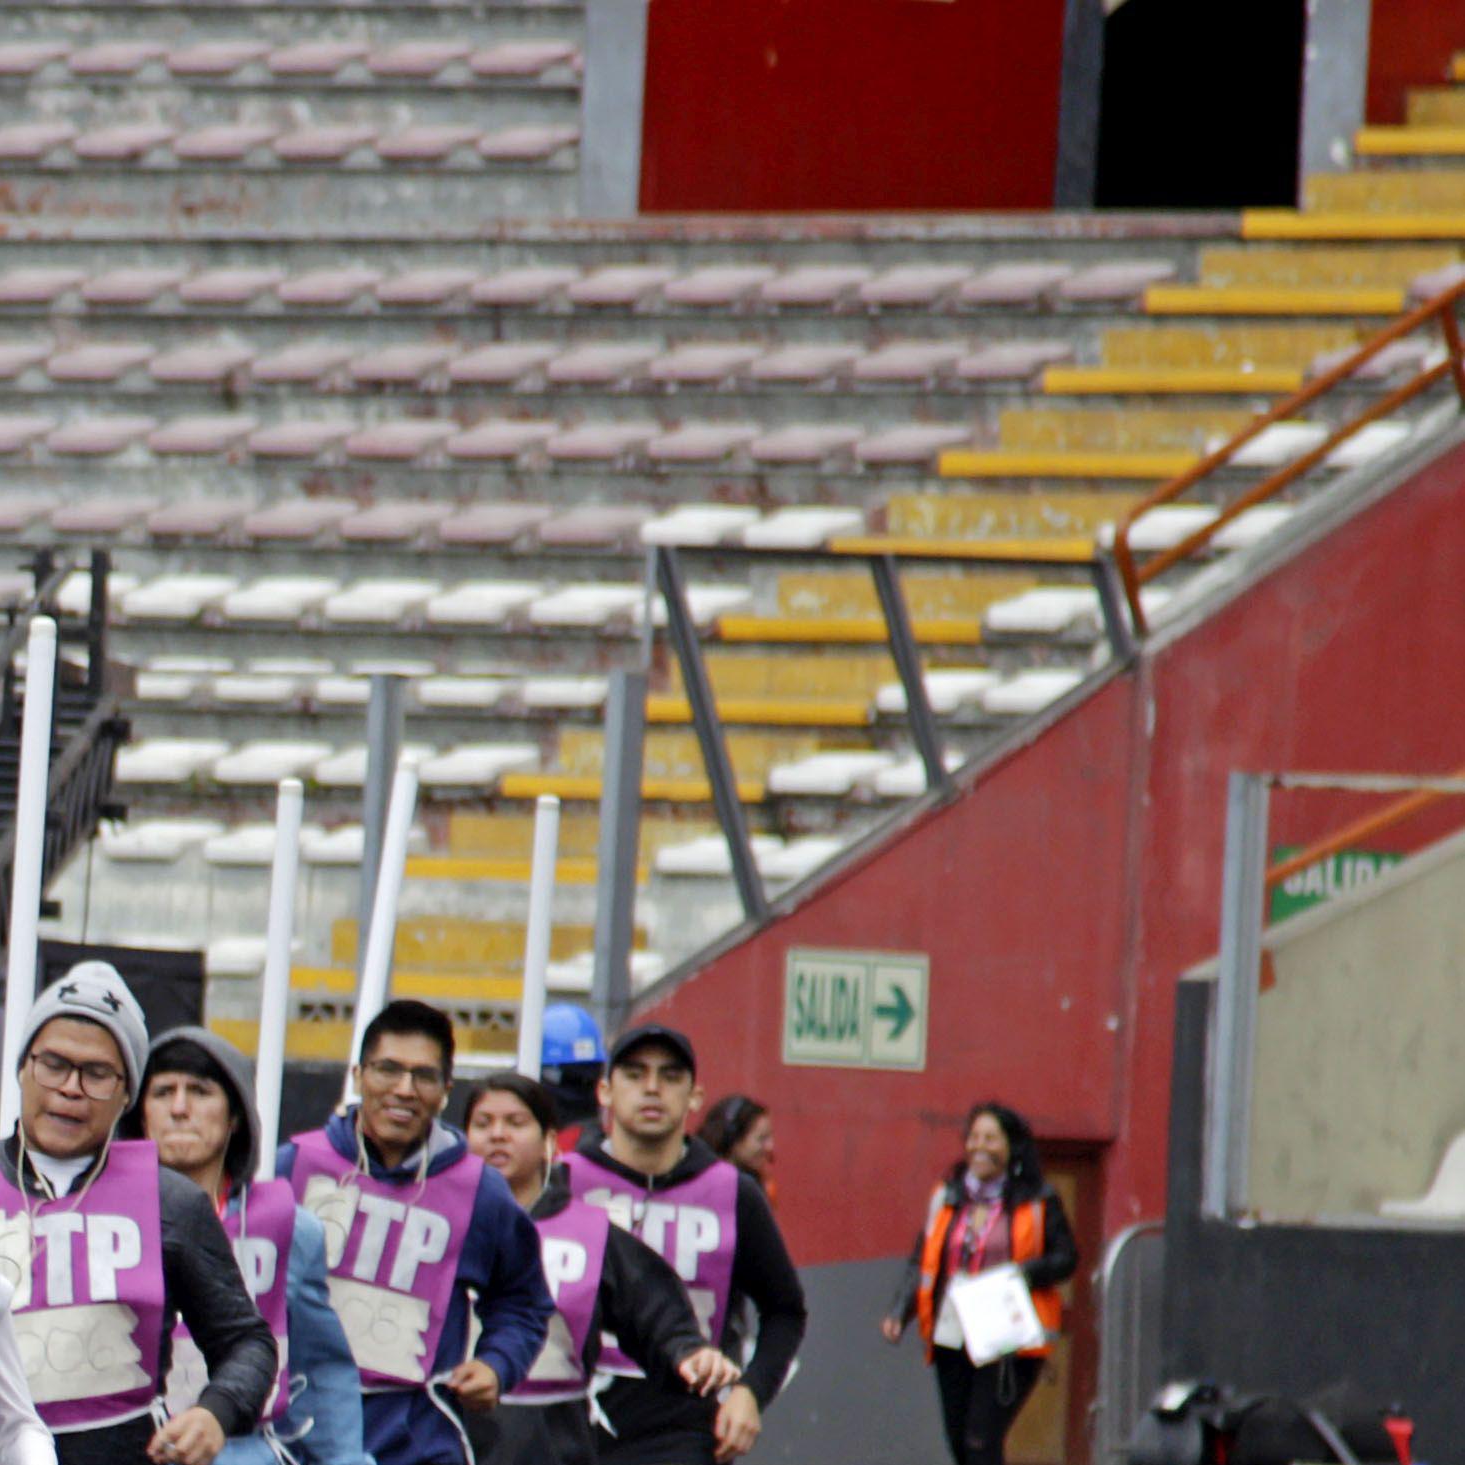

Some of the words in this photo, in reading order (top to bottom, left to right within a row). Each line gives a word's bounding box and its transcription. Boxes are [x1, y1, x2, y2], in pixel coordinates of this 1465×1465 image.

[1282, 856, 1393, 897] SALID
[794, 972, 860, 1040] SALIDA
[342, 1297, 401, 1346] 08
